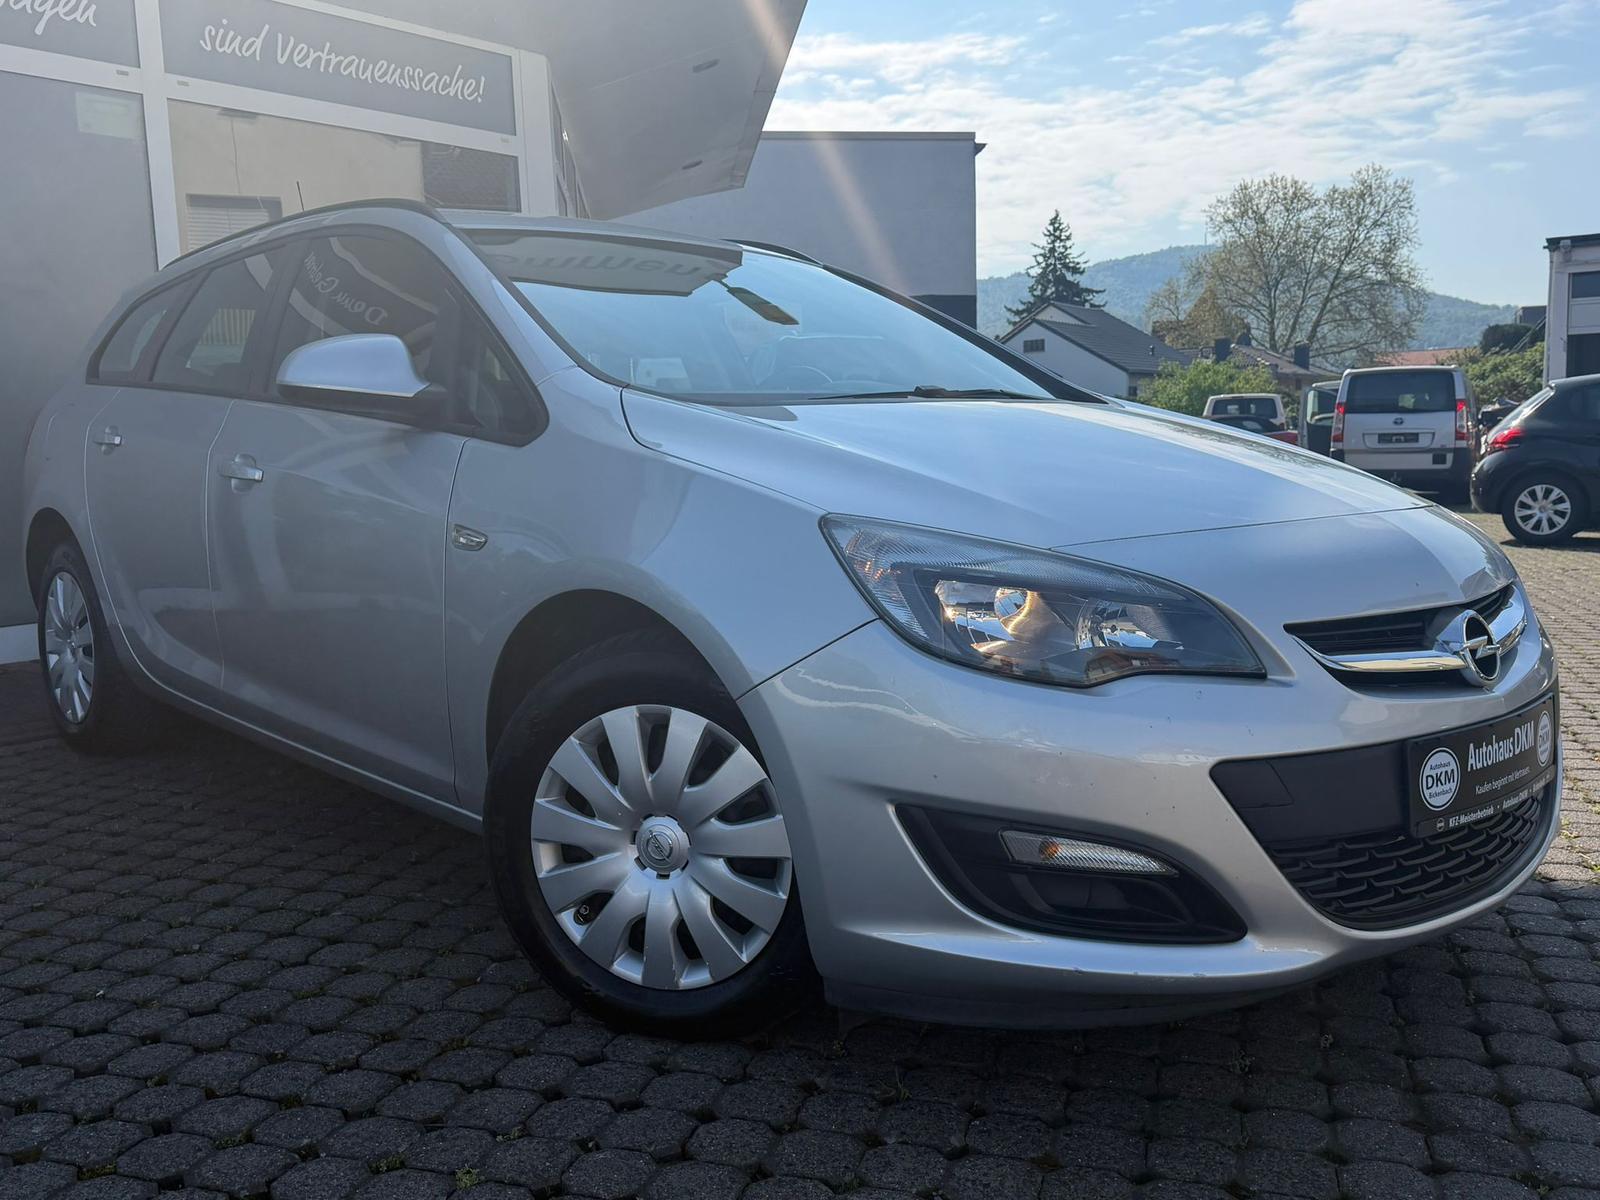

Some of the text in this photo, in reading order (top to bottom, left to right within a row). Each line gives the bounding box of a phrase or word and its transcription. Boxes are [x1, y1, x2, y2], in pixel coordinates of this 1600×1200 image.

[200, 18, 486, 103] sind Vertrauenssache!
[1514, 720, 1535, 755] DKM
[1425, 768, 1455, 790] DKM
